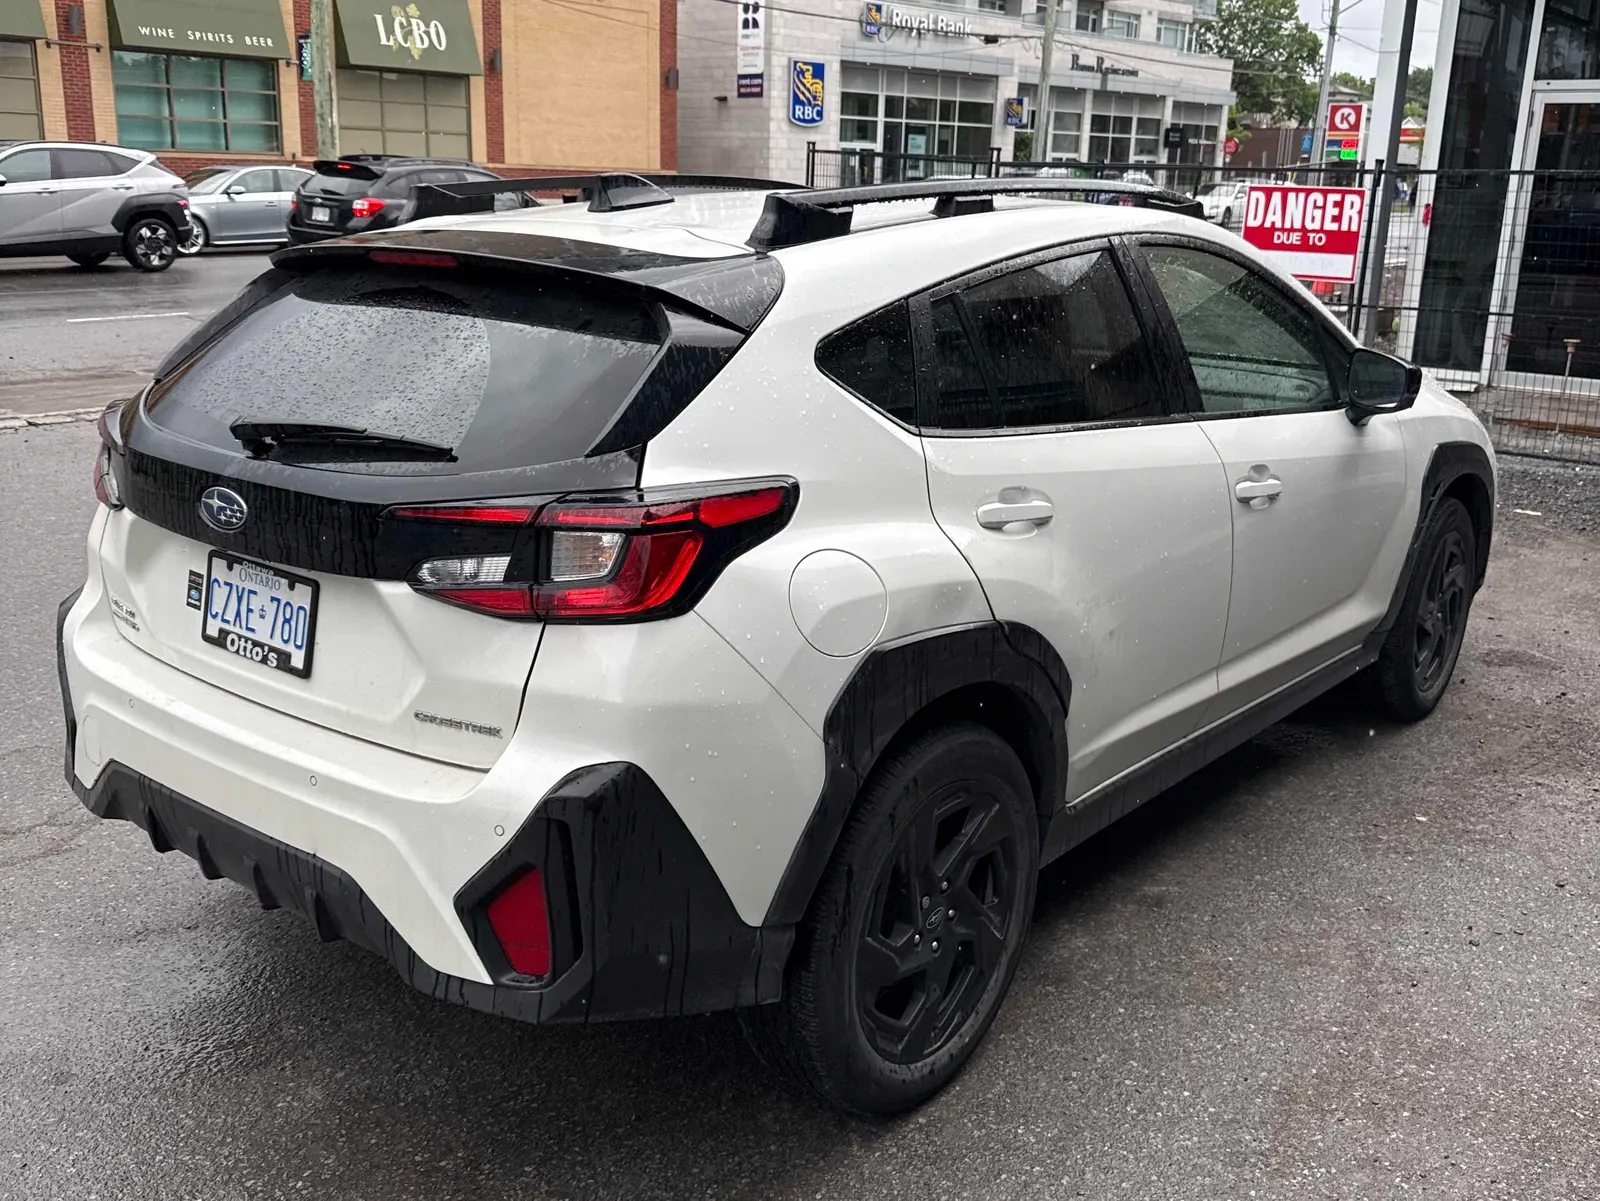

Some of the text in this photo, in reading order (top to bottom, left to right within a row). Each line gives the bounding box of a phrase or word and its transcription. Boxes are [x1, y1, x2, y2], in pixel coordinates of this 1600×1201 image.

[138, 25, 274, 47] WINE SPIRITS BEER
[373, 13, 447, 51] LCBO
[866, 25, 880, 34] RBC
[892, 8, 972, 38] Royal Bank
[795, 104, 822, 120] RBC
[1246, 190, 1361, 232] DANGER
[1273, 231, 1327, 246] DUE TO
[209, 577, 308, 650] CZXE 780
[226, 633, 279, 668] Otto's
[413, 710, 503, 740] CROSSTREK
